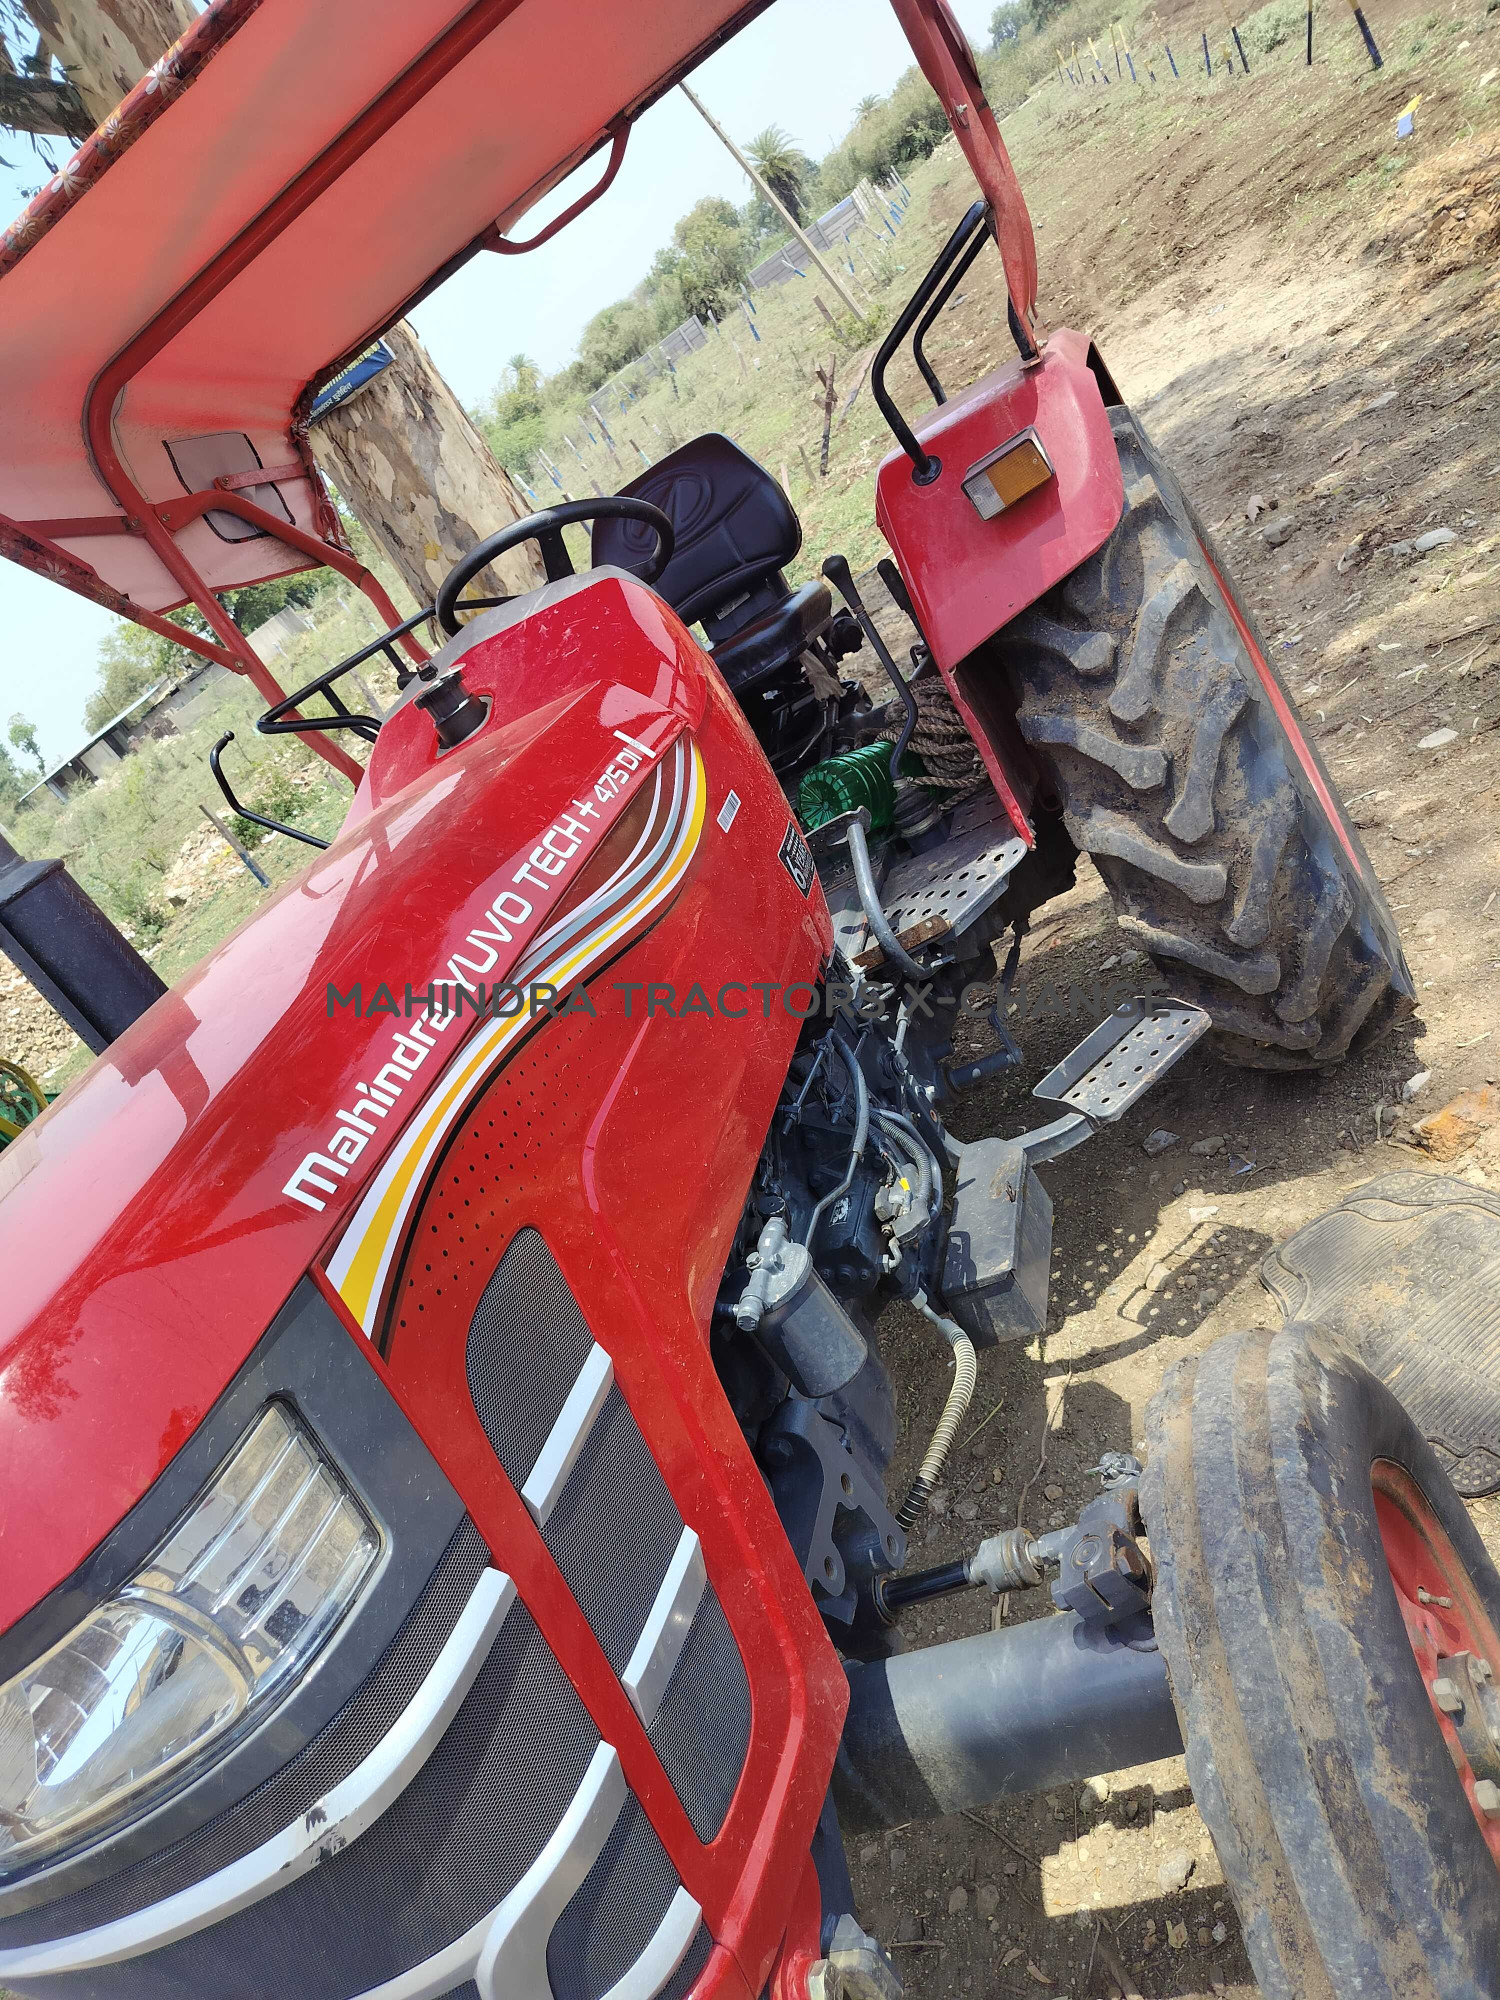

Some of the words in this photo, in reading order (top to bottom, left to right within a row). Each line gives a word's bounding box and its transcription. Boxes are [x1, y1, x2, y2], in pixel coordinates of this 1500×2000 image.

[282, 1001, 456, 1212] Mahindra
[433, 891, 533, 993] YUVO
[593, 764, 630, 803] 475
[615, 747, 643, 771] DI
[785, 855, 807, 890] 6
